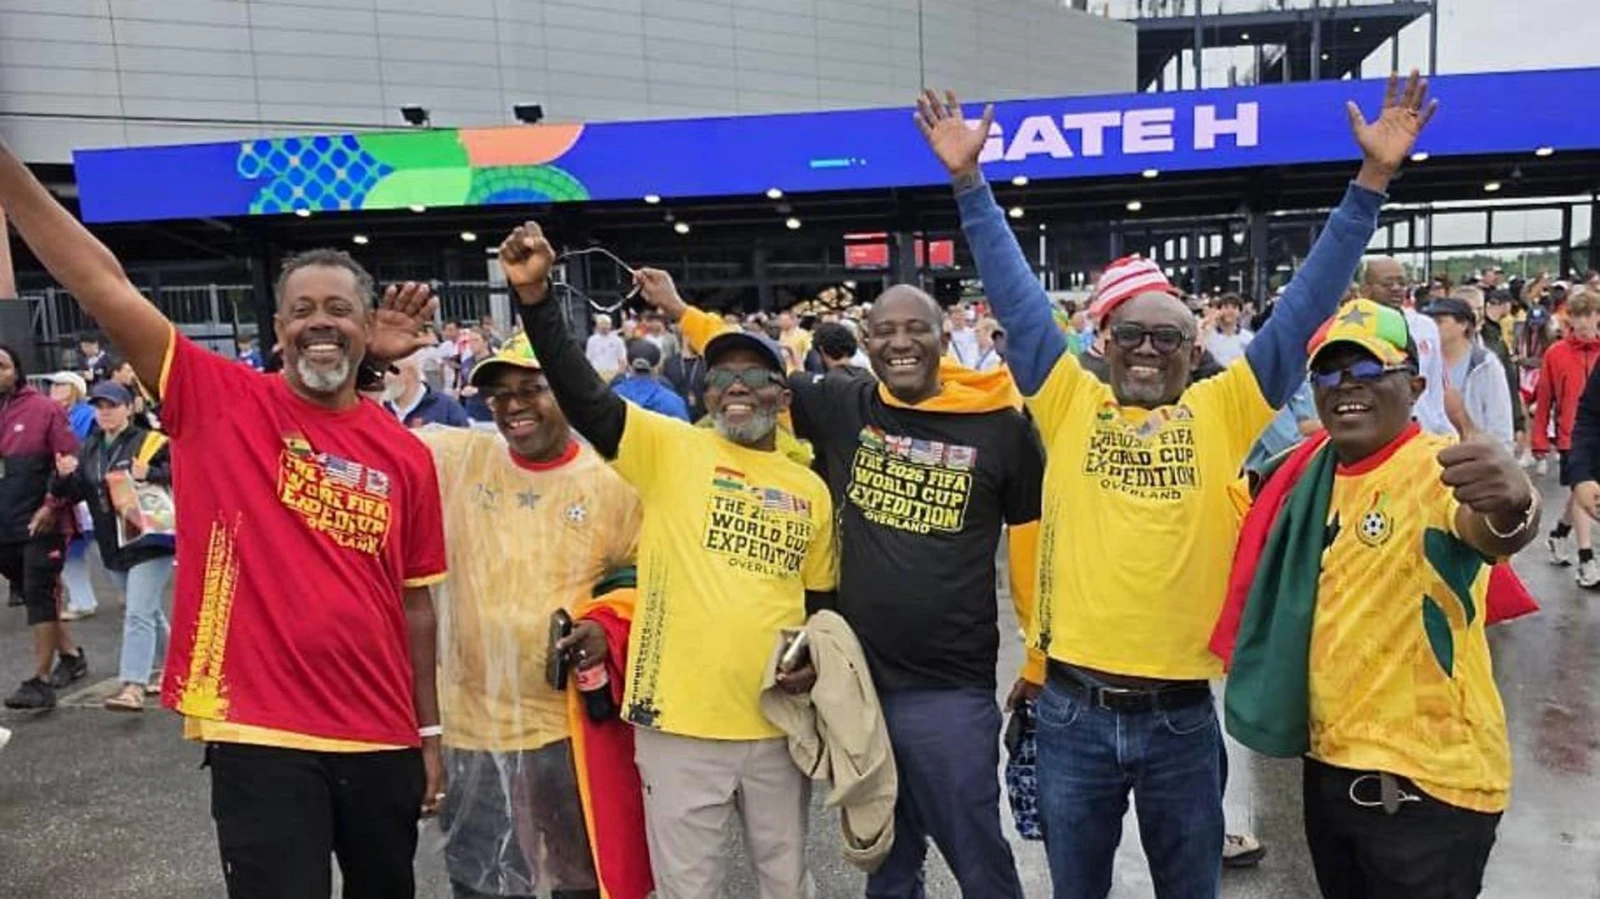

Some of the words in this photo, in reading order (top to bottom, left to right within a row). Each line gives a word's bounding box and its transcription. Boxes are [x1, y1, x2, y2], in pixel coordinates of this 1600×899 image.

[1194, 101, 1258, 150] H
[1160, 427, 1194, 445] FIFA
[1159, 446, 1194, 464] CUP
[855, 466, 918, 498] WORLD
[921, 487, 965, 508] CUP
[859, 451, 885, 470] THE
[885, 460, 925, 482] 2026
[927, 471, 967, 492] FIFA
[346, 494, 387, 520] FIFA
[714, 495, 746, 516] THE
[848, 483, 961, 528] EXPEDITION
[712, 511, 781, 543] WORLD
[864, 511, 931, 535] OVERLAND
[706, 529, 805, 572] EXPEDITION
